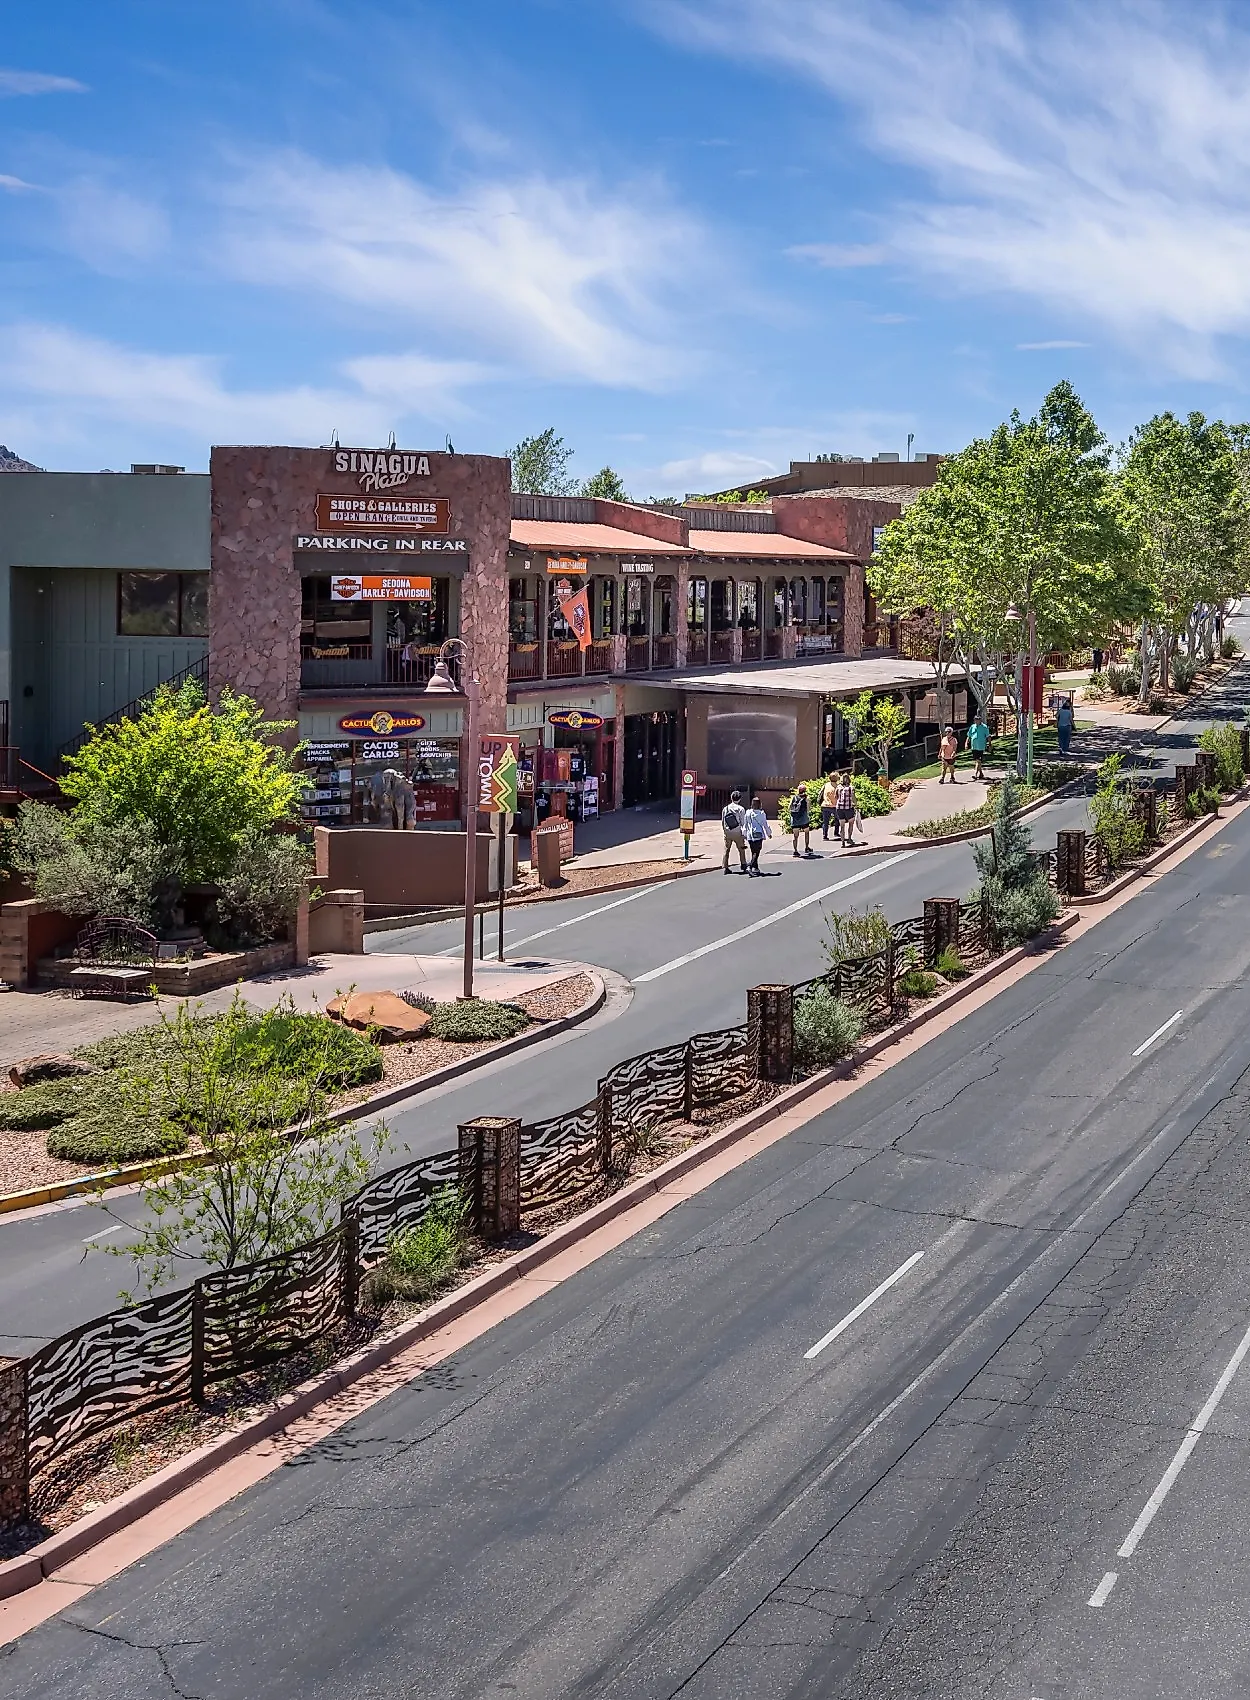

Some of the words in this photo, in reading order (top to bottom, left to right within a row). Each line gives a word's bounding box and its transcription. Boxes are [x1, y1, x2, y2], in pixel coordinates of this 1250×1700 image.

[336, 452, 430, 475] SINAGUA
[359, 472, 408, 492] Plaza
[330, 500, 365, 511] SHOPS
[367, 500, 376, 511] &
[378, 502, 437, 513] GALLERIES
[335, 512, 359, 521] OPEN
[365, 513, 396, 522] RANGE
[297, 537, 388, 550] PARKING
[395, 539, 415, 550] IN
[421, 540, 467, 550] REAR
[635, 563, 654, 573] TASTING
[382, 579, 411, 588] SEDONA
[362, 588, 430, 598] HARLEY-DAVIDSON
[342, 719, 373, 728] CACTUS
[391, 718, 422, 727] CARLOS
[363, 742, 398, 750] CACTUS
[482, 742, 501, 757] UP
[363, 750, 400, 759] CARLOS
[479, 754, 494, 805] TOWN
